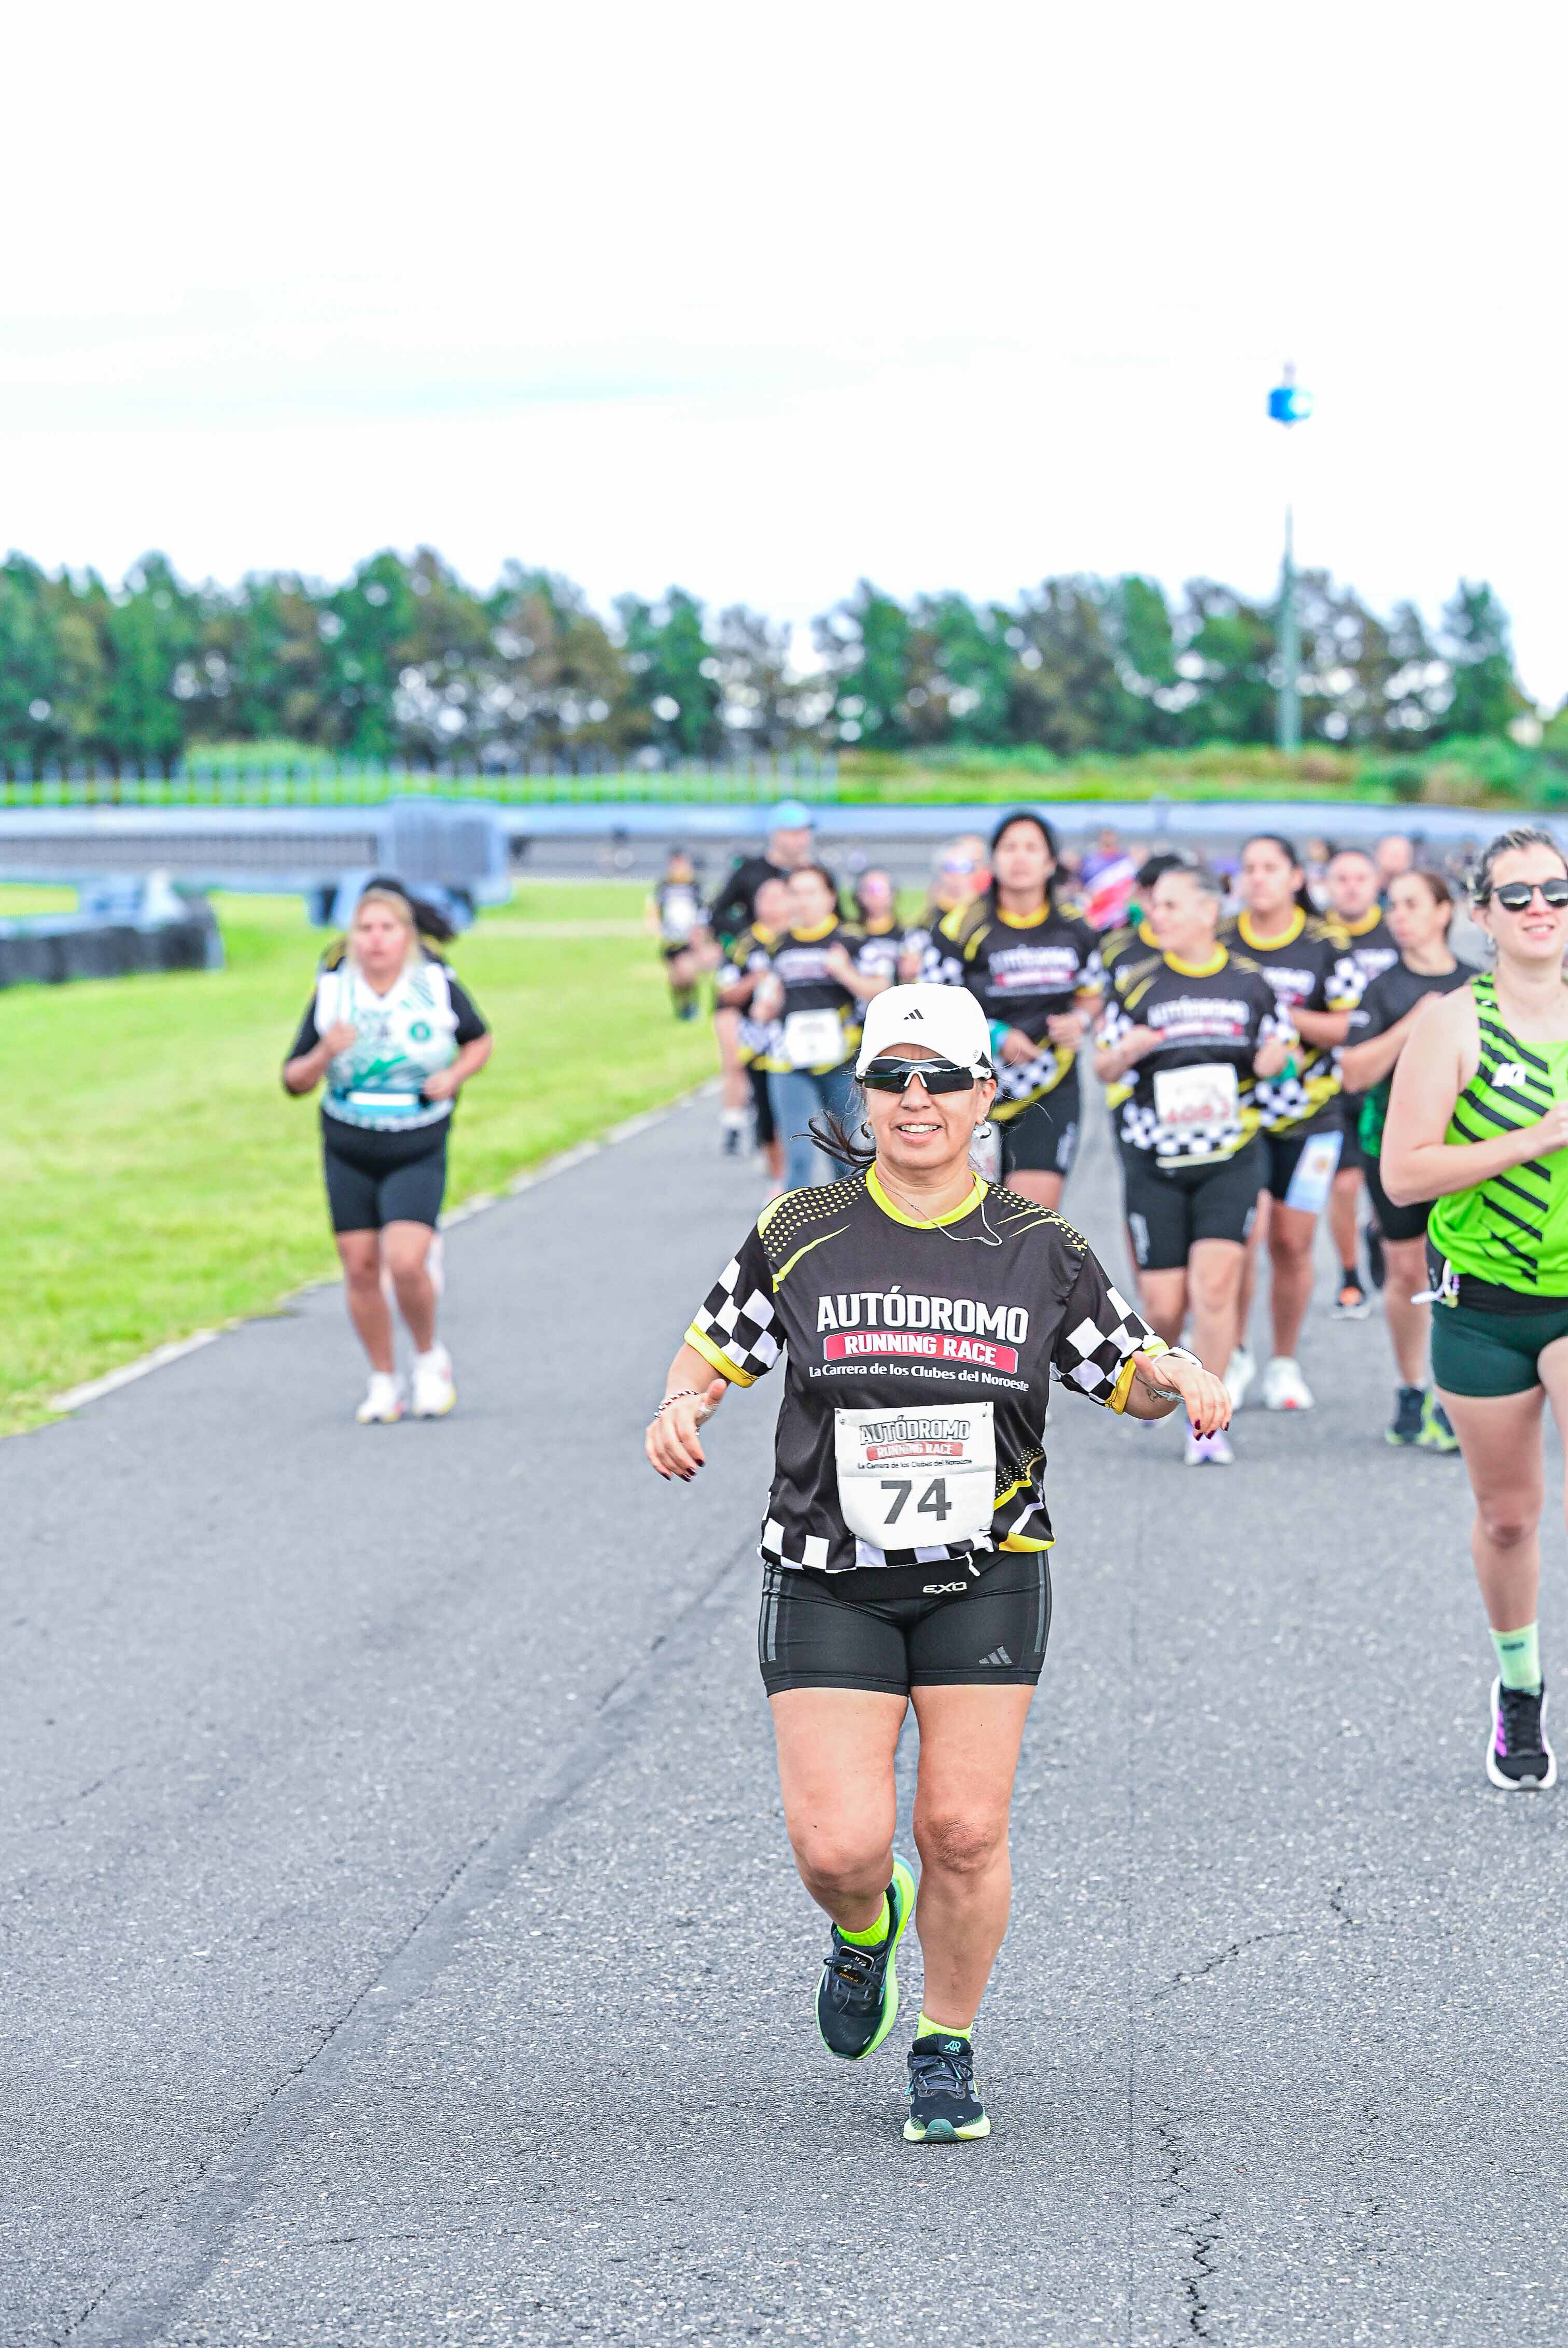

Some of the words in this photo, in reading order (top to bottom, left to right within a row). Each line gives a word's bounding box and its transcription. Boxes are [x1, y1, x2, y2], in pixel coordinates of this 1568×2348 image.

[817, 1285, 1029, 1344] AUTÓDROMO
[844, 1334, 937, 1355] RUNNING
[943, 1338, 997, 1366] RACE
[809, 1366, 821, 1377] La
[822, 1364, 867, 1376] Carrera
[870, 1363, 888, 1375] de
[890, 1363, 909, 1375] los
[911, 1365, 956, 1380] Clubes
[958, 1369, 979, 1382] del
[981, 1372, 1029, 1392] Noroeste
[859, 1415, 971, 1445] AUTÓDROMO
[876, 1443, 923, 1458] RUNNING
[925, 1443, 954, 1455] RACE
[881, 1478, 952, 1524] 74
